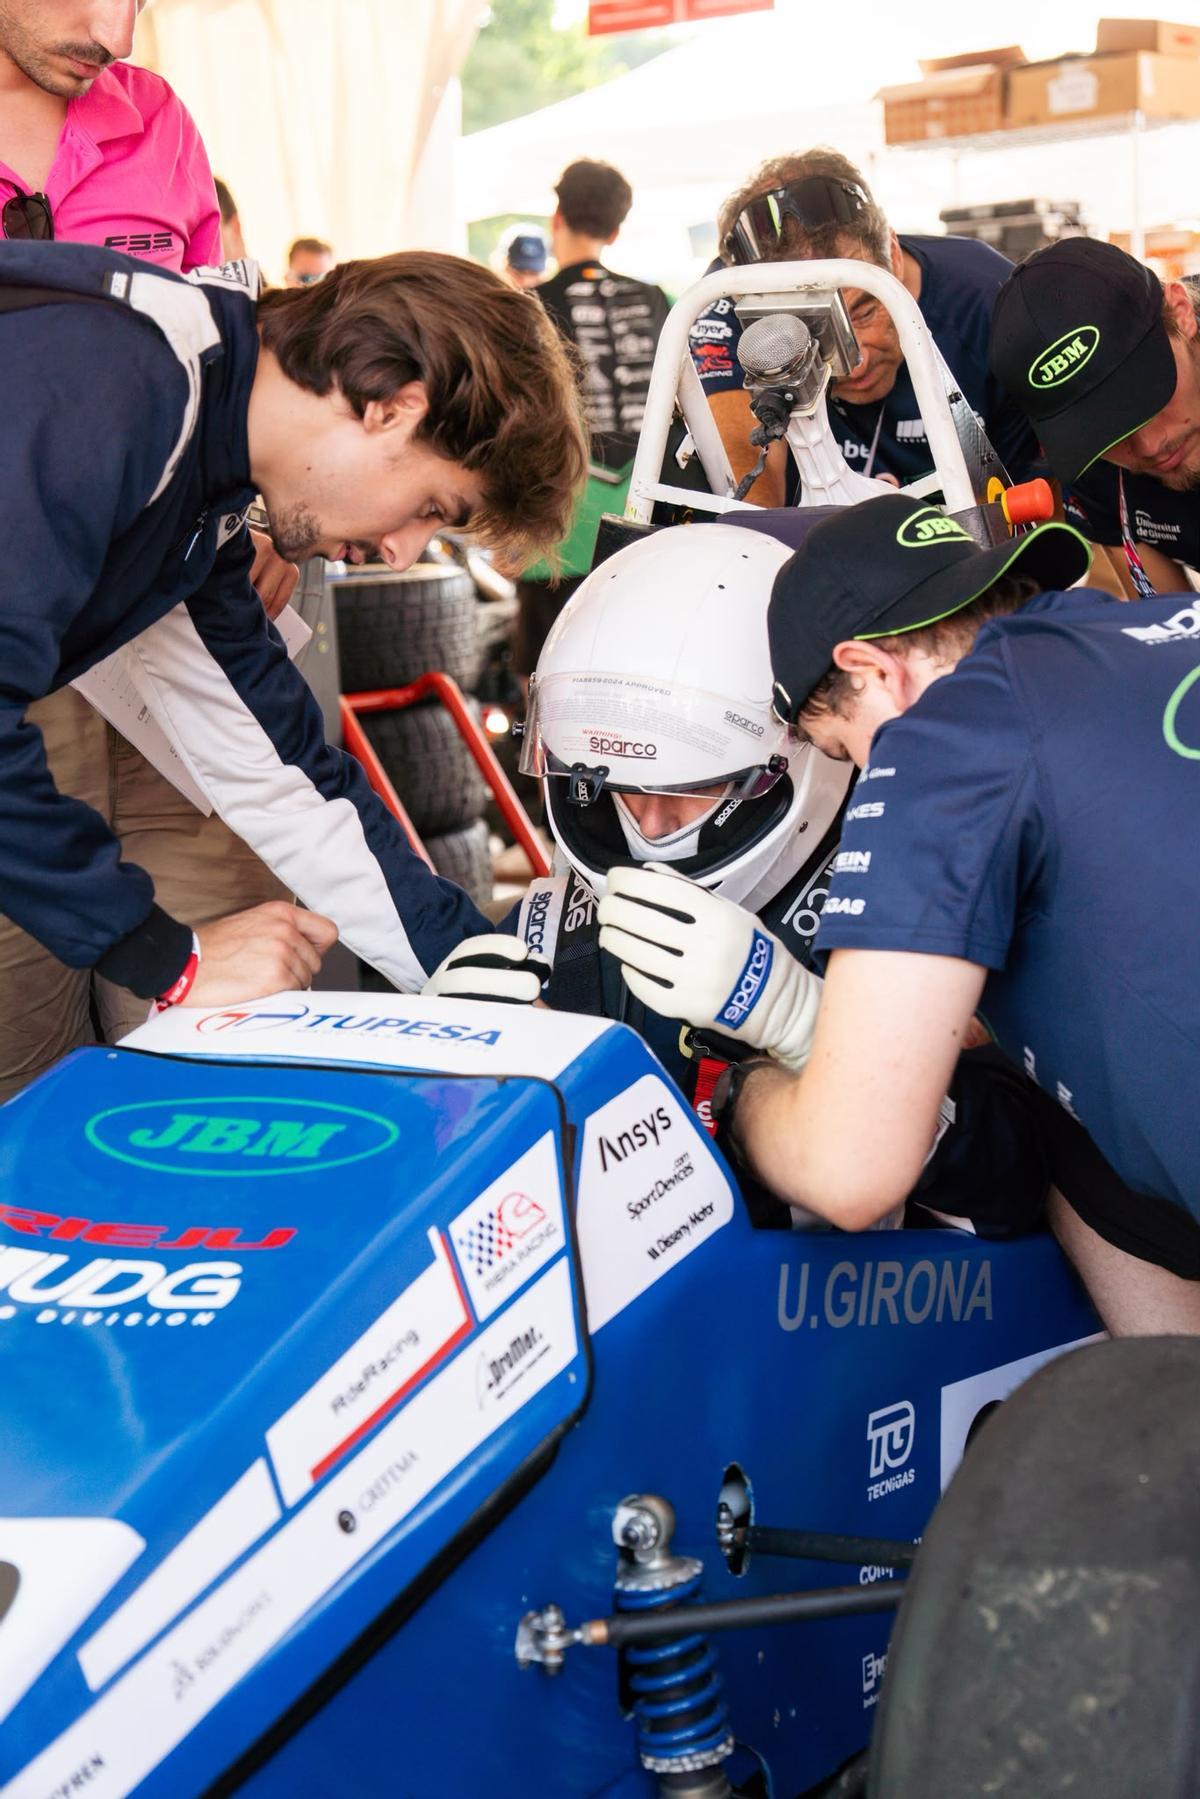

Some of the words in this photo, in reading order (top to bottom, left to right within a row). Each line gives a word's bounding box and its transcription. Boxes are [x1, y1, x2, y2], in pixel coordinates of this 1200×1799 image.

[1039, 336, 1089, 382] JBM
[1136, 516, 1181, 534] Universitat
[1136, 528, 1148, 537] de
[1148, 530, 1178, 541] Girona
[723, 710, 765, 737] sparco
[589, 736, 657, 759] sparco
[723, 938, 772, 1025] sparco
[305, 1013, 502, 1046] TUPESA
[128, 1113, 347, 1158] JBM
[598, 1107, 672, 1172] Ansys
[627, 1163, 695, 1221] SportDevices
[0, 1203, 298, 1250] RIEJU
[689, 1202, 715, 1228] Motor
[778, 1260, 993, 1331] U.GIRONA
[35, 1305, 216, 1327] DIVISION
